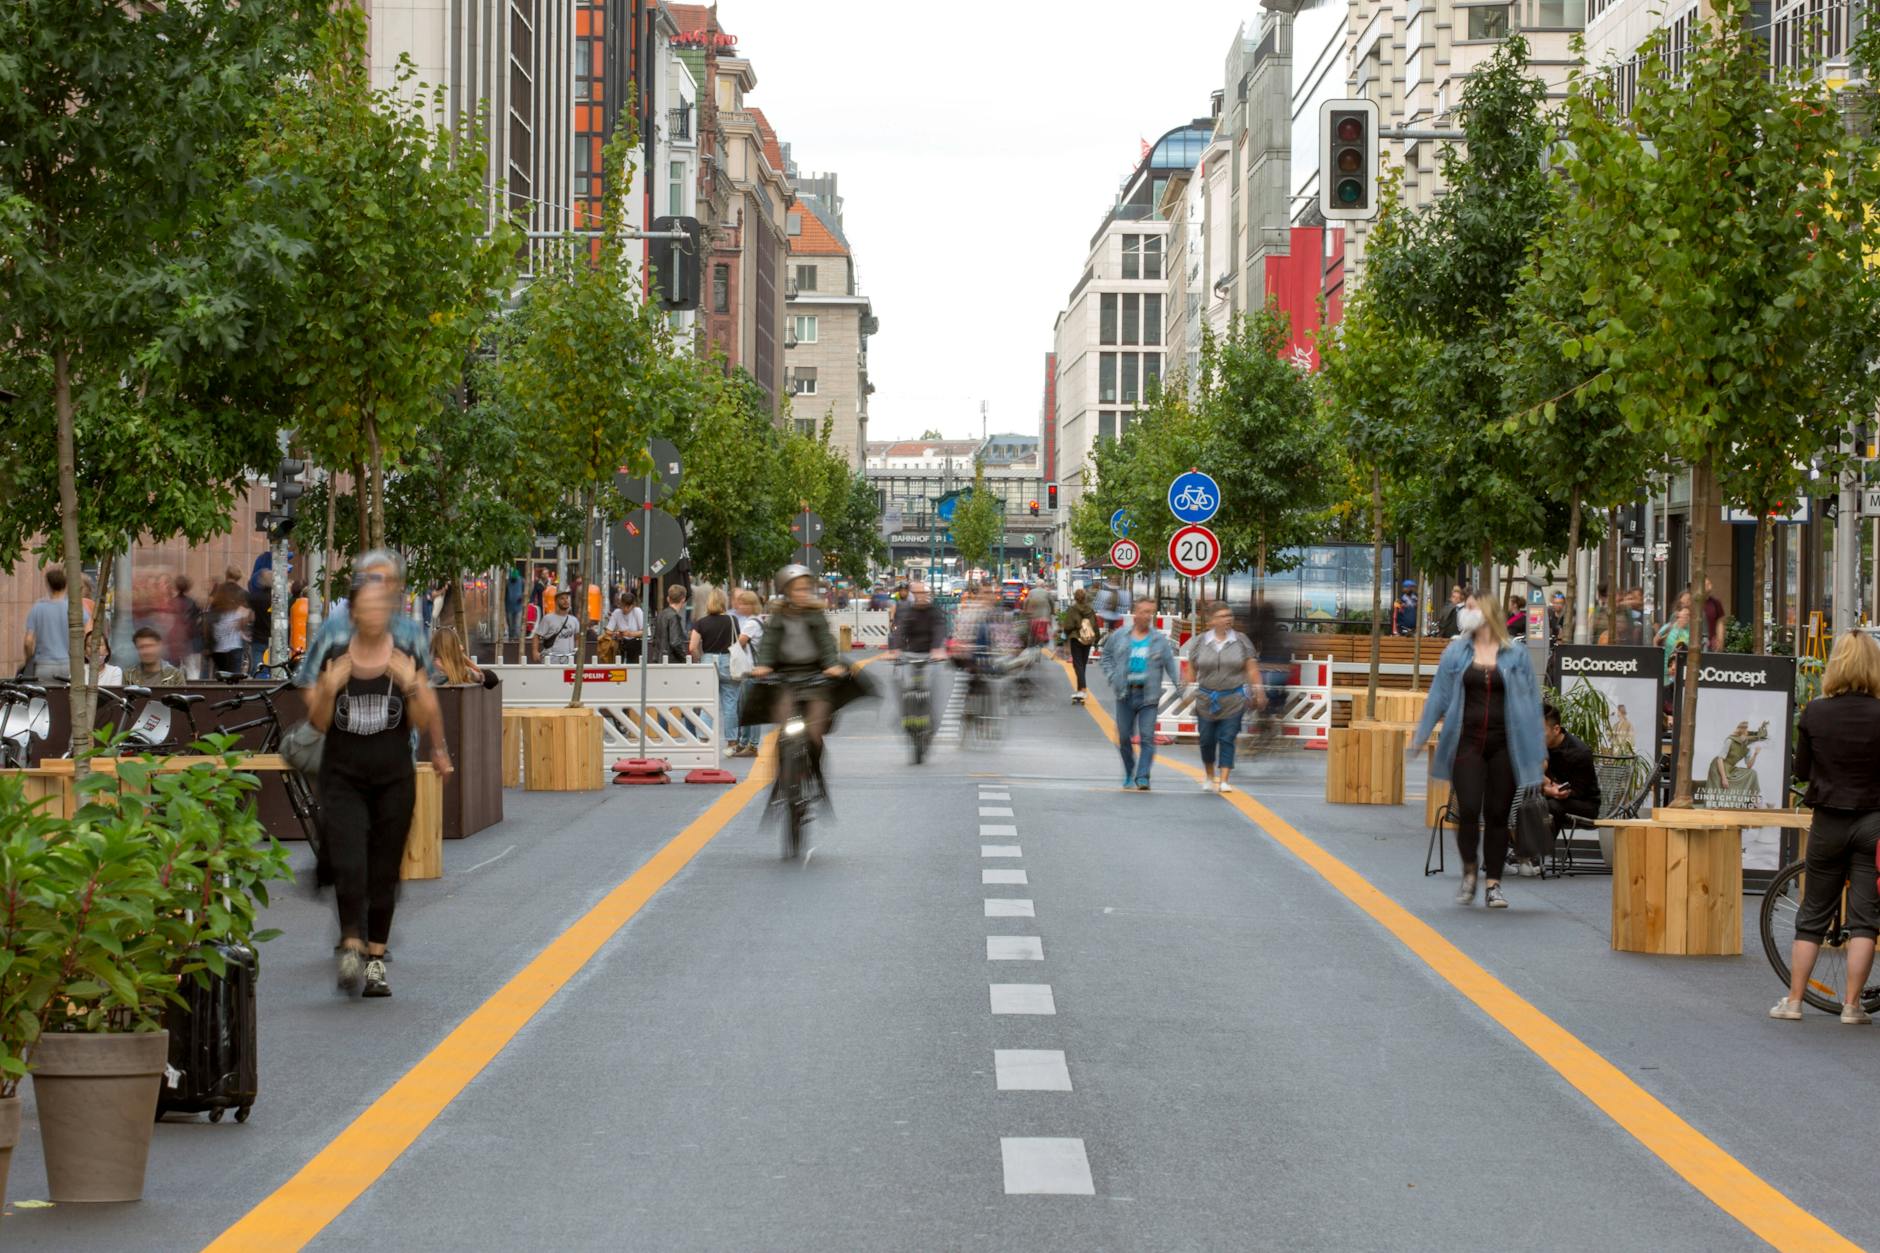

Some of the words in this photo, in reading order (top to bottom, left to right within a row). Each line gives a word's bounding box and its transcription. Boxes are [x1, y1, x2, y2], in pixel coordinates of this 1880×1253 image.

[891, 535, 930, 543] BAHNHOF
[1117, 548, 1133, 561] 20
[1181, 540, 1208, 562] 20
[1533, 590, 1542, 602] P
[1561, 656, 1638, 675] BoConcept
